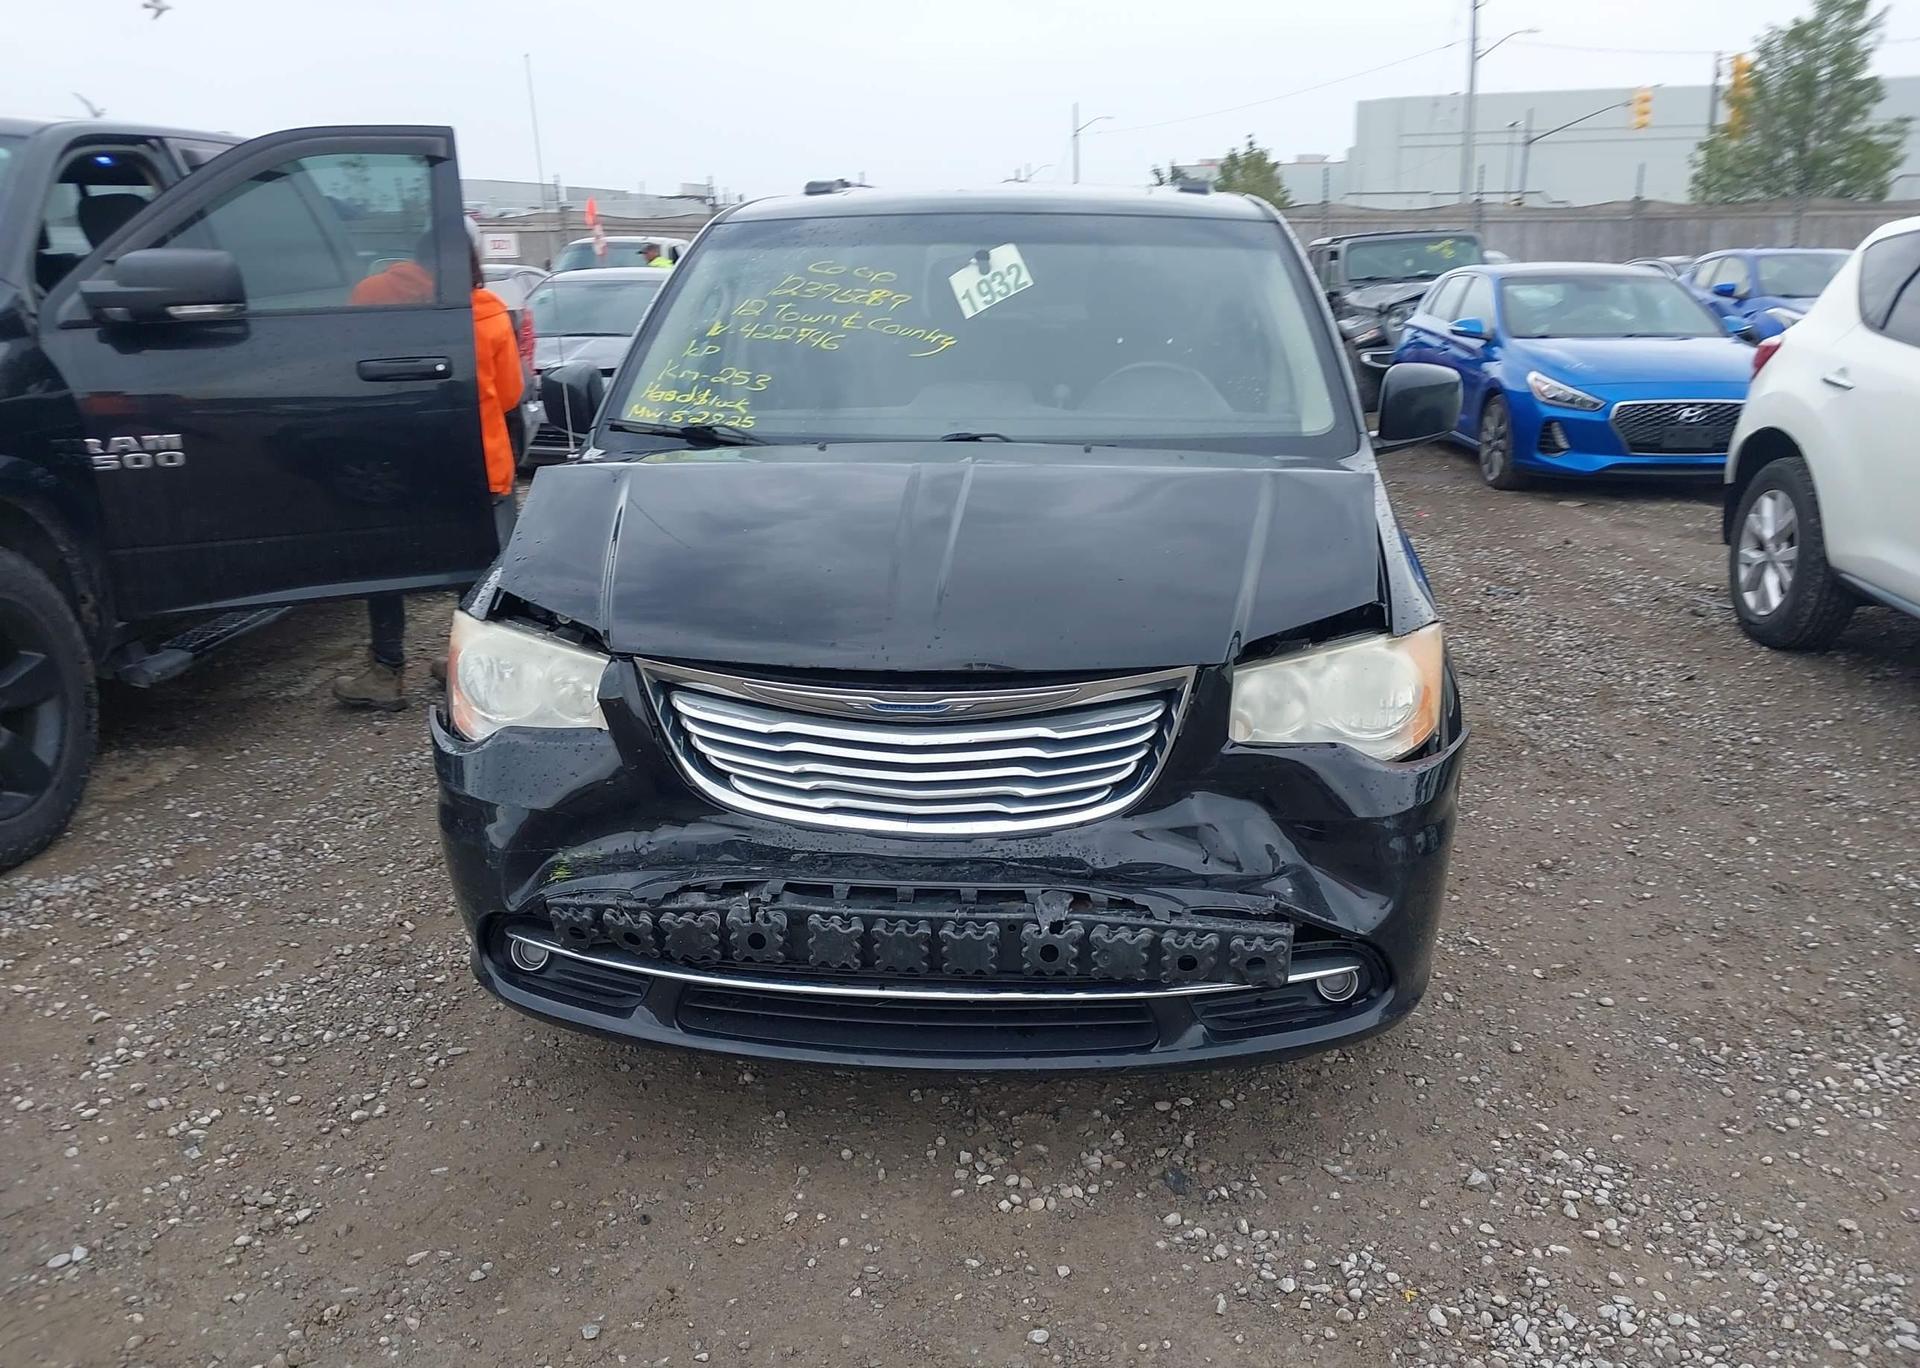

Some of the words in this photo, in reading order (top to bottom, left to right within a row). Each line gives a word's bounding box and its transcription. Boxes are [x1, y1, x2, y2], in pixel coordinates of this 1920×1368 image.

[961, 262, 1030, 313] 1932
[731, 298, 769, 317] 12
[867, 317, 959, 358] Country
